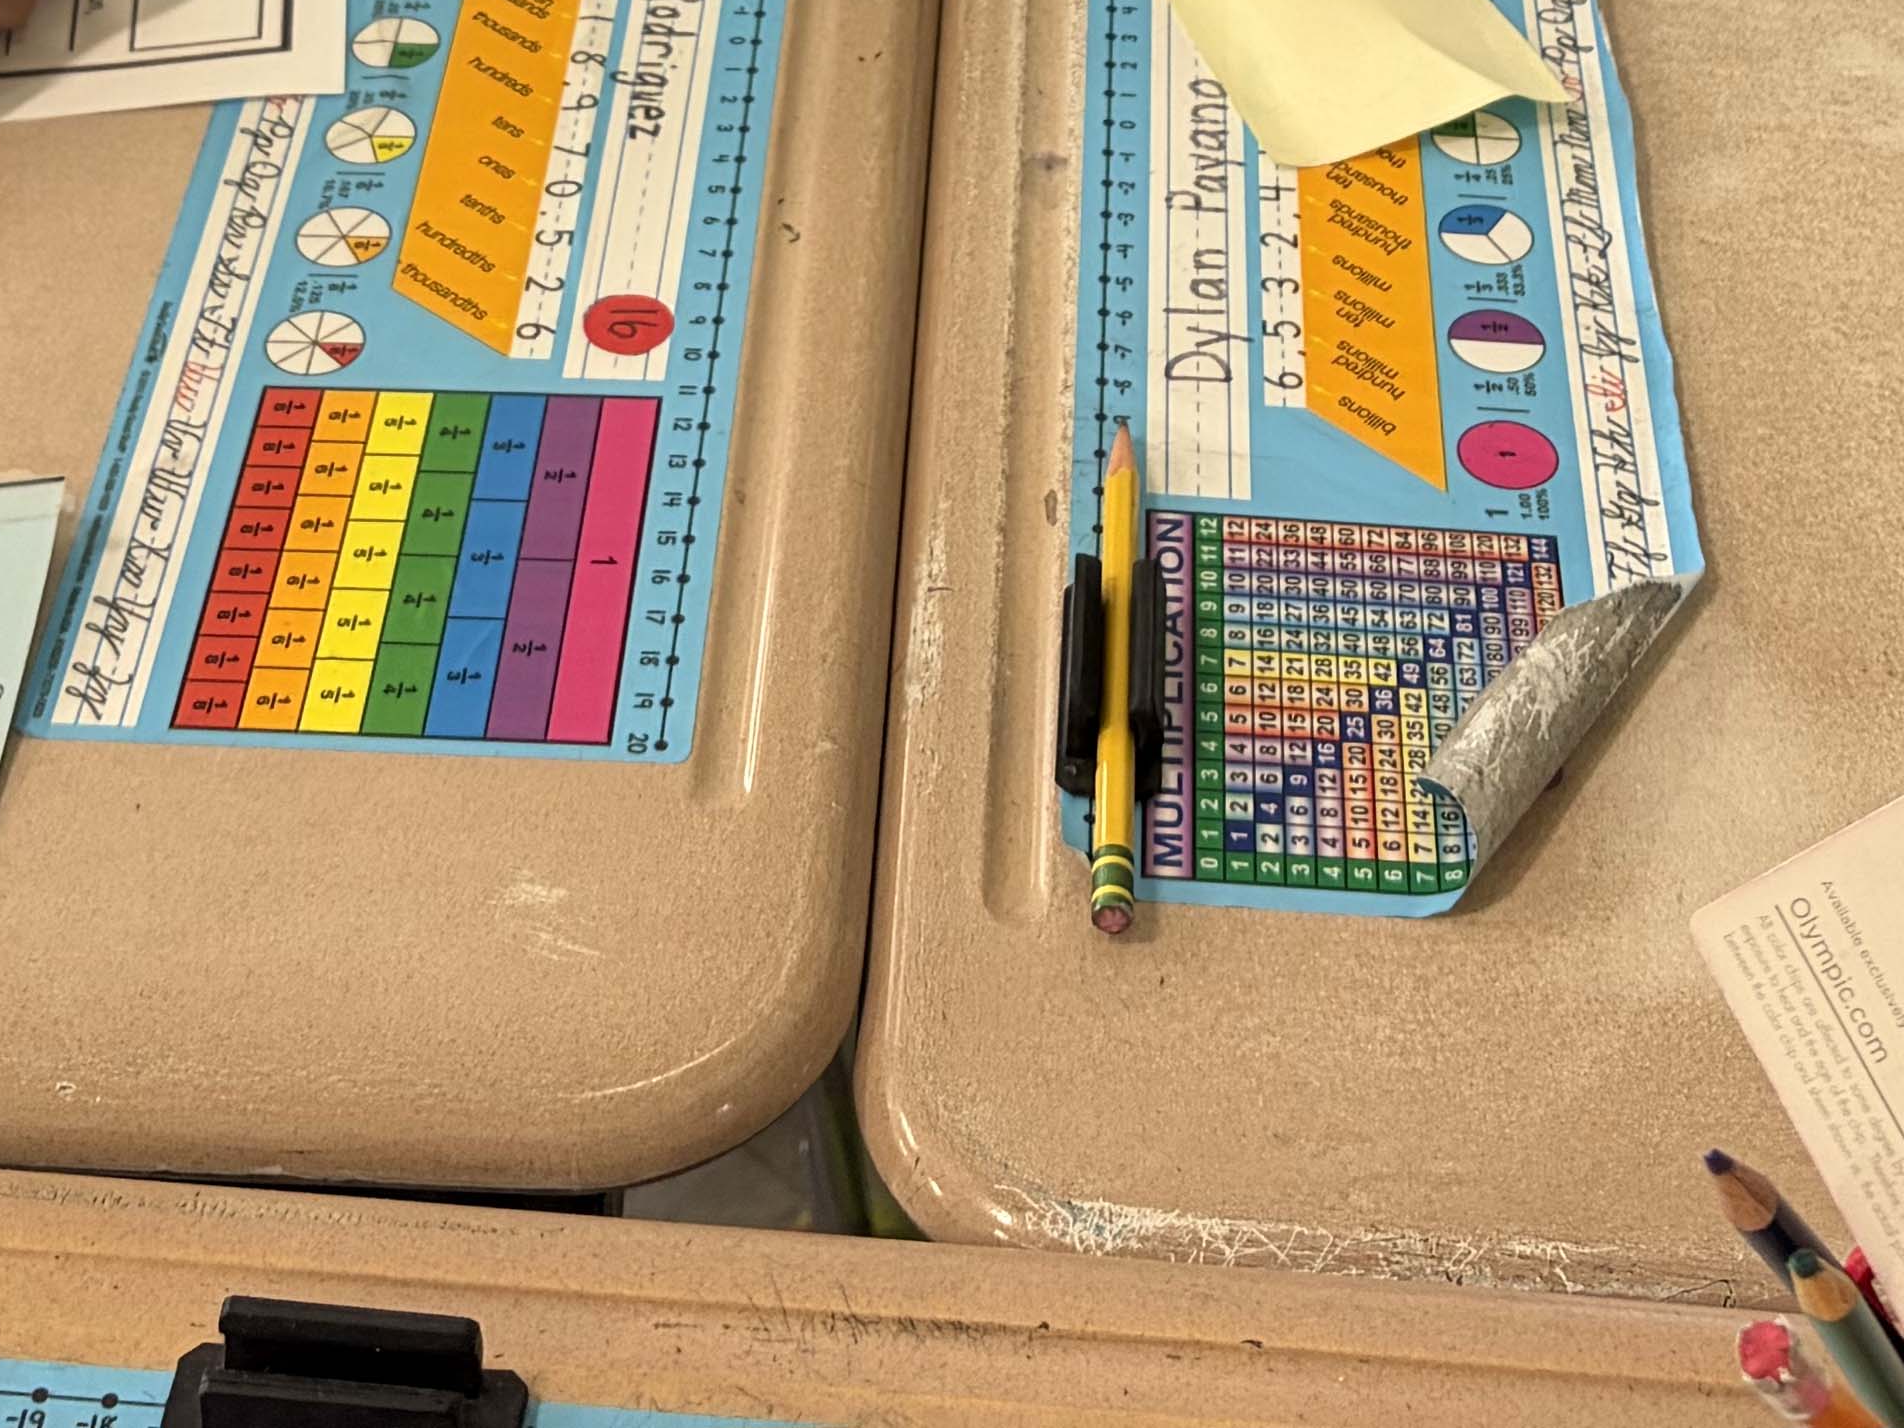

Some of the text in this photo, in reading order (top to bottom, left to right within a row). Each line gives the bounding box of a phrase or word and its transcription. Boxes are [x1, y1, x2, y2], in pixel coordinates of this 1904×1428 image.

[468, 56, 534, 97] hundreds
[491, 116, 525, 138] tens
[478, 155, 515, 179] ones
[459, 194, 506, 225] tenths
[1163, 78, 1255, 383] Dylan Payano
[1329, 198, 1413, 250] thousands
[415, 220, 497, 273] hundredths
[1327, 212, 1397, 256] hundred
[400, 263, 489, 321] thousandths
[1331, 254, 1393, 293] millions
[607, 307, 660, 340] 16
[1333, 289, 1396, 329] millions
[1335, 306, 1365, 328] ten
[1331, 354, 1406, 401] hundred
[1336, 339, 1399, 380] millions
[1338, 394, 1397, 437] billions
[626, 416, 693, 754] 12 13 14 15 16 17 18 19 20
[1819, 880, 1863, 946] Available
[1789, 896, 1887, 1063] Olympic.com
